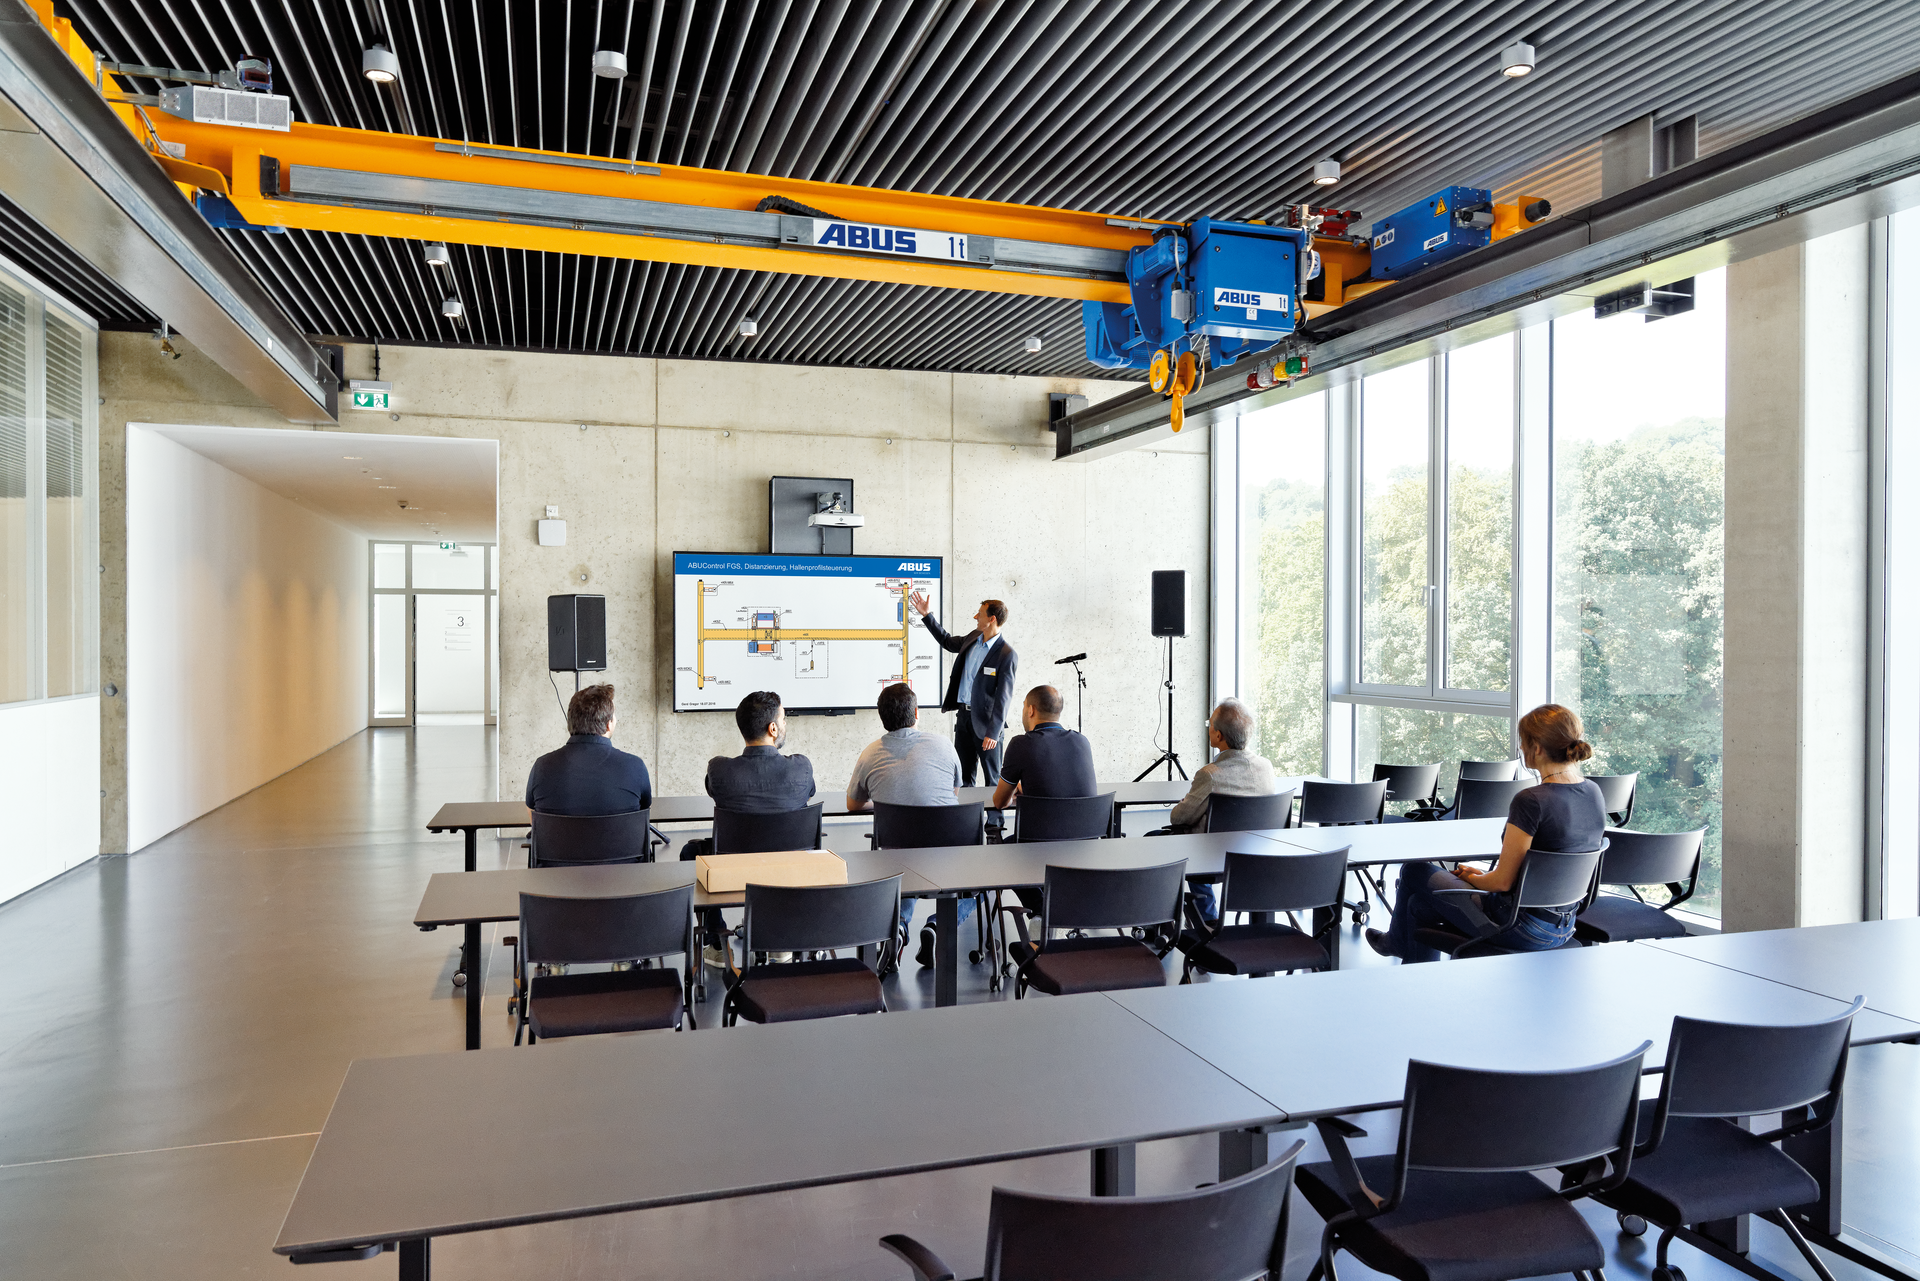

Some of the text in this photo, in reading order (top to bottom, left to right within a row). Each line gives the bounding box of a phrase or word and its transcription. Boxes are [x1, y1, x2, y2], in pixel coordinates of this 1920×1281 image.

[817, 223, 917, 254] ABUS
[1427, 235, 1444, 247] ABUS
[1217, 291, 1261, 306] ABUS
[726, 563, 743, 571] FGS,
[744, 563, 788, 572] Distanzierung,
[789, 564, 853, 572] Hallenprofilsteuerung
[897, 562, 931, 572] ABUS
[457, 616, 464, 627] 3
